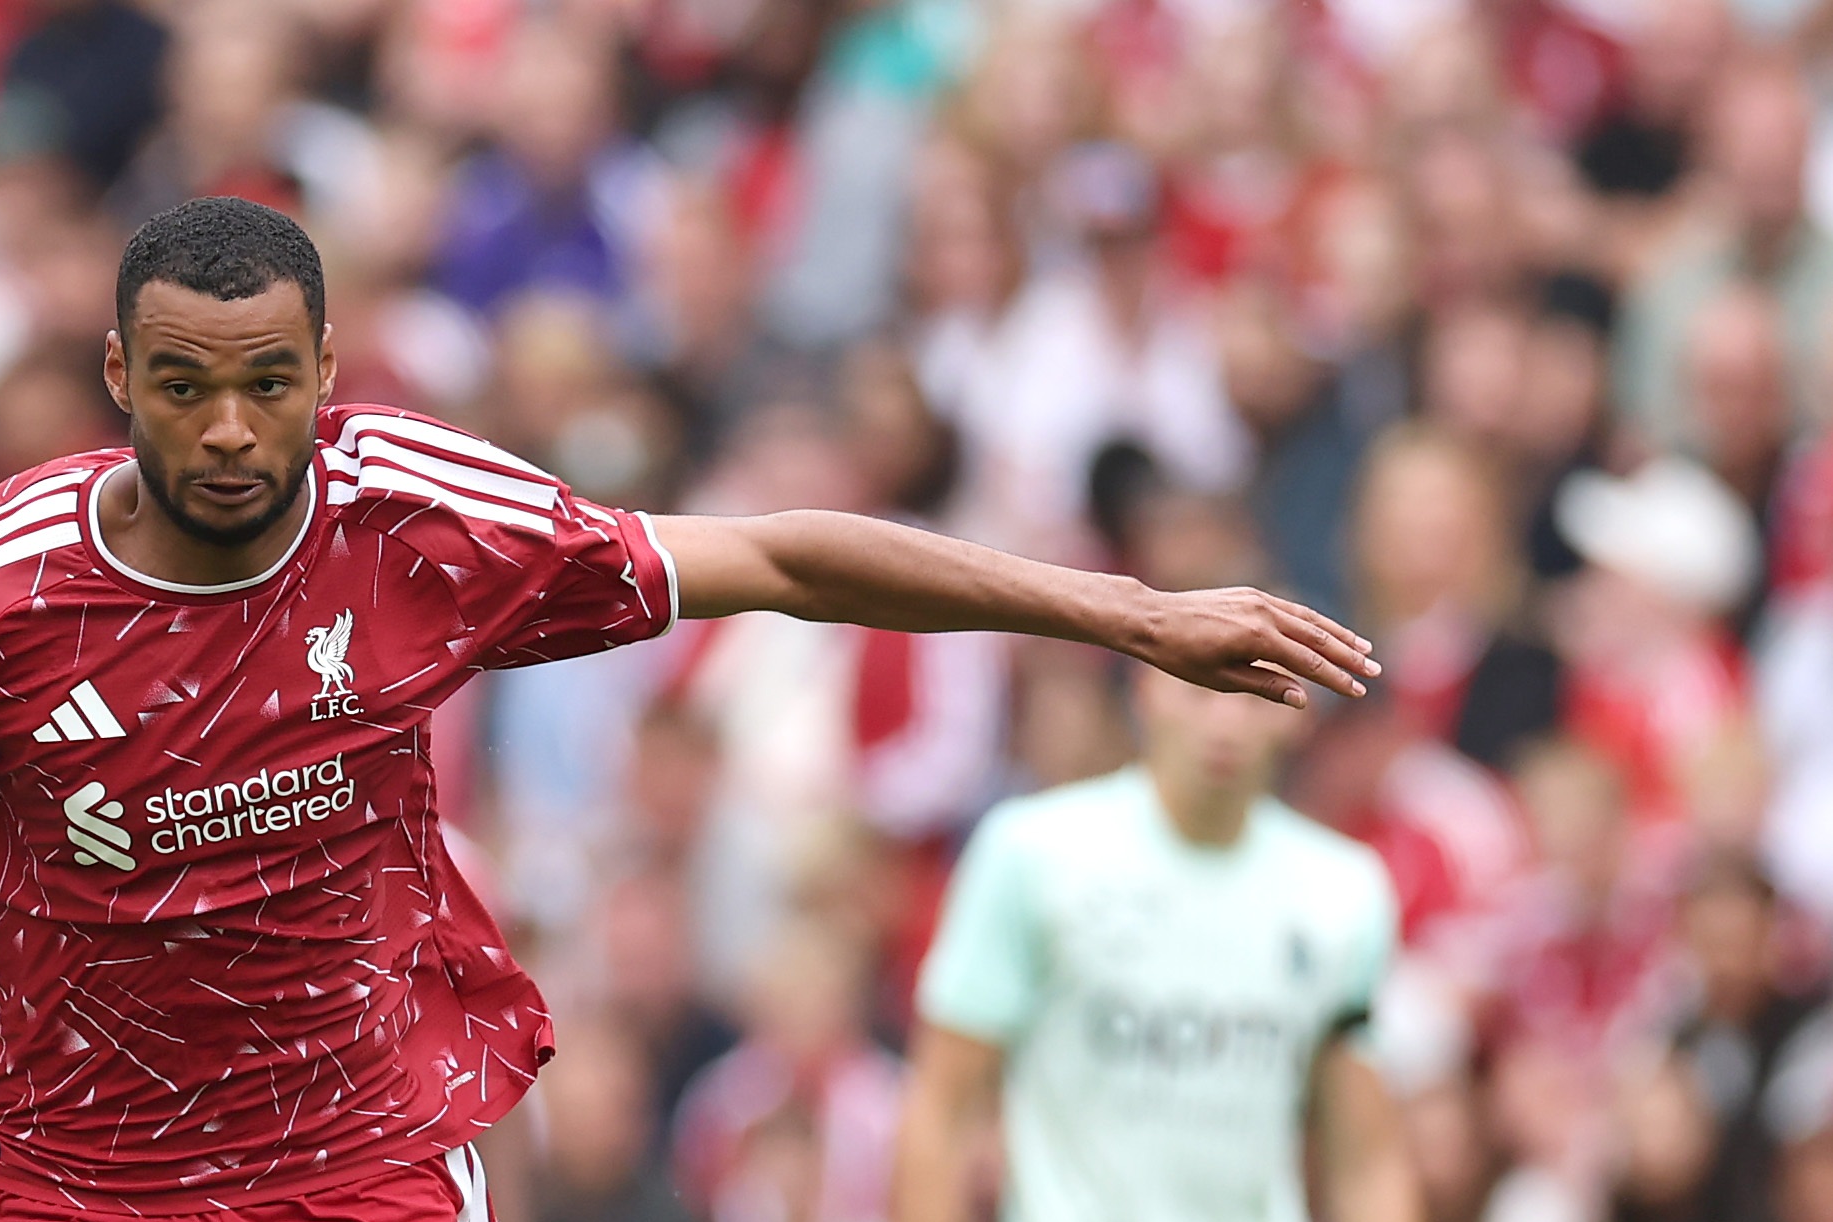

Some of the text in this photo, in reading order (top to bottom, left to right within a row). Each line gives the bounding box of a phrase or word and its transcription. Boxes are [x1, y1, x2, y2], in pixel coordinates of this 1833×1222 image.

[310, 694, 365, 722] L.F.C.
[145, 752, 345, 824] standard
[151, 778, 355, 854] chartered
